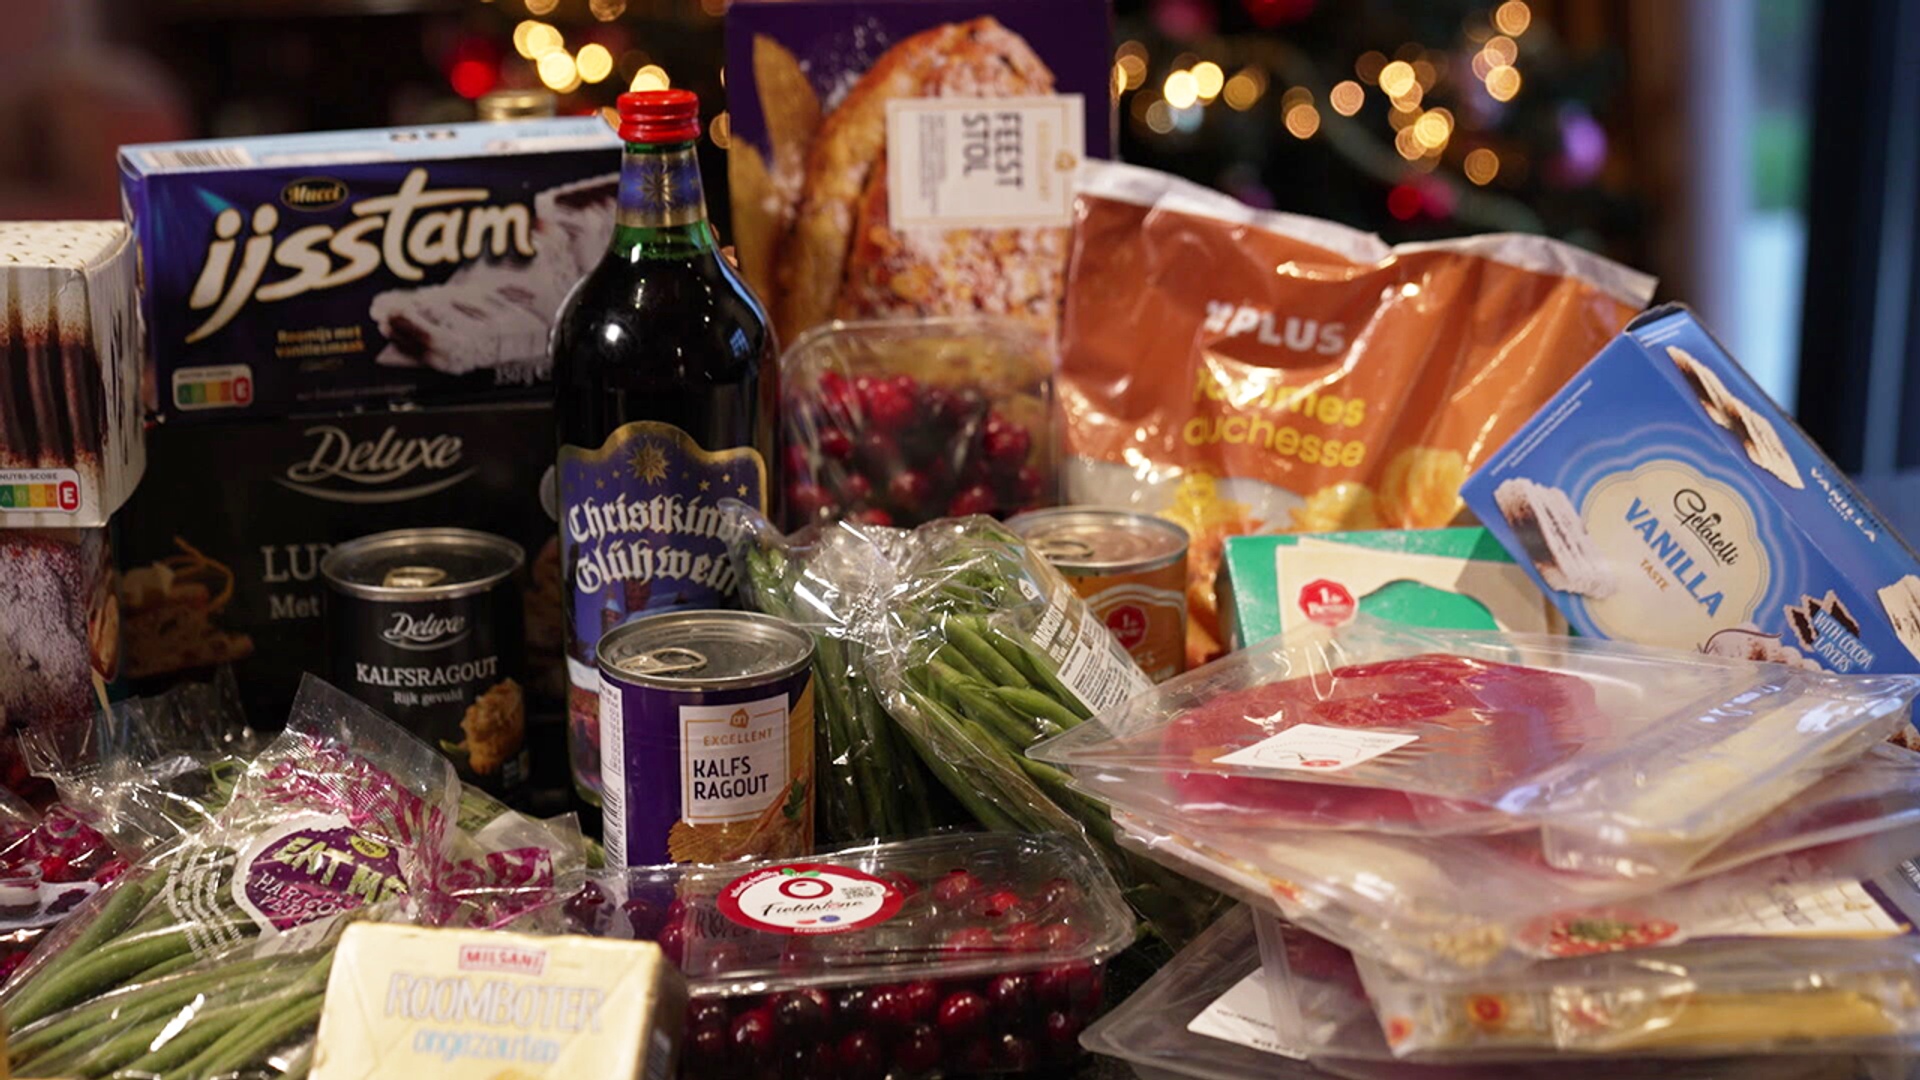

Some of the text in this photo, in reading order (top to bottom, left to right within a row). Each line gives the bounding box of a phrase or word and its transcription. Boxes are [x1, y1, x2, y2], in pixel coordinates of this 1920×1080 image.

[962, 113, 990, 176] STOL
[995, 112, 1023, 190] FEEST
[287, 184, 341, 204] Mucci
[185, 167, 535, 343] ijsstam
[1225, 305, 1346, 355] PLUS
[287, 425, 463, 484] Deluxe
[63, 487, 75, 504] E
[1811, 467, 1876, 543] VANILLA
[1673, 488, 1739, 567] Gelatelli
[261, 542, 331, 583] LU
[575, 539, 738, 596] Glühwein
[1625, 496, 1725, 618] VANILLA
[1640, 558, 1670, 591] TASTE
[270, 594, 320, 620] Met
[383, 611, 465, 642] Deluxe
[1814, 611, 1873, 669] WITH COCOA
[1814, 636, 1851, 673] LAYERS
[355, 655, 499, 687] KALFSRAGOUT
[393, 687, 464, 707] Rijk gevuld
[703, 727, 773, 747] EXCELLENT
[693, 756, 752, 778] KALFS
[694, 773, 769, 800] RAGOUT
[272, 837, 355, 885] EAT
[253, 871, 346, 916] HARICO
[466, 951, 541, 967] MILSANI
[383, 972, 606, 1033] ROOMBOTER
